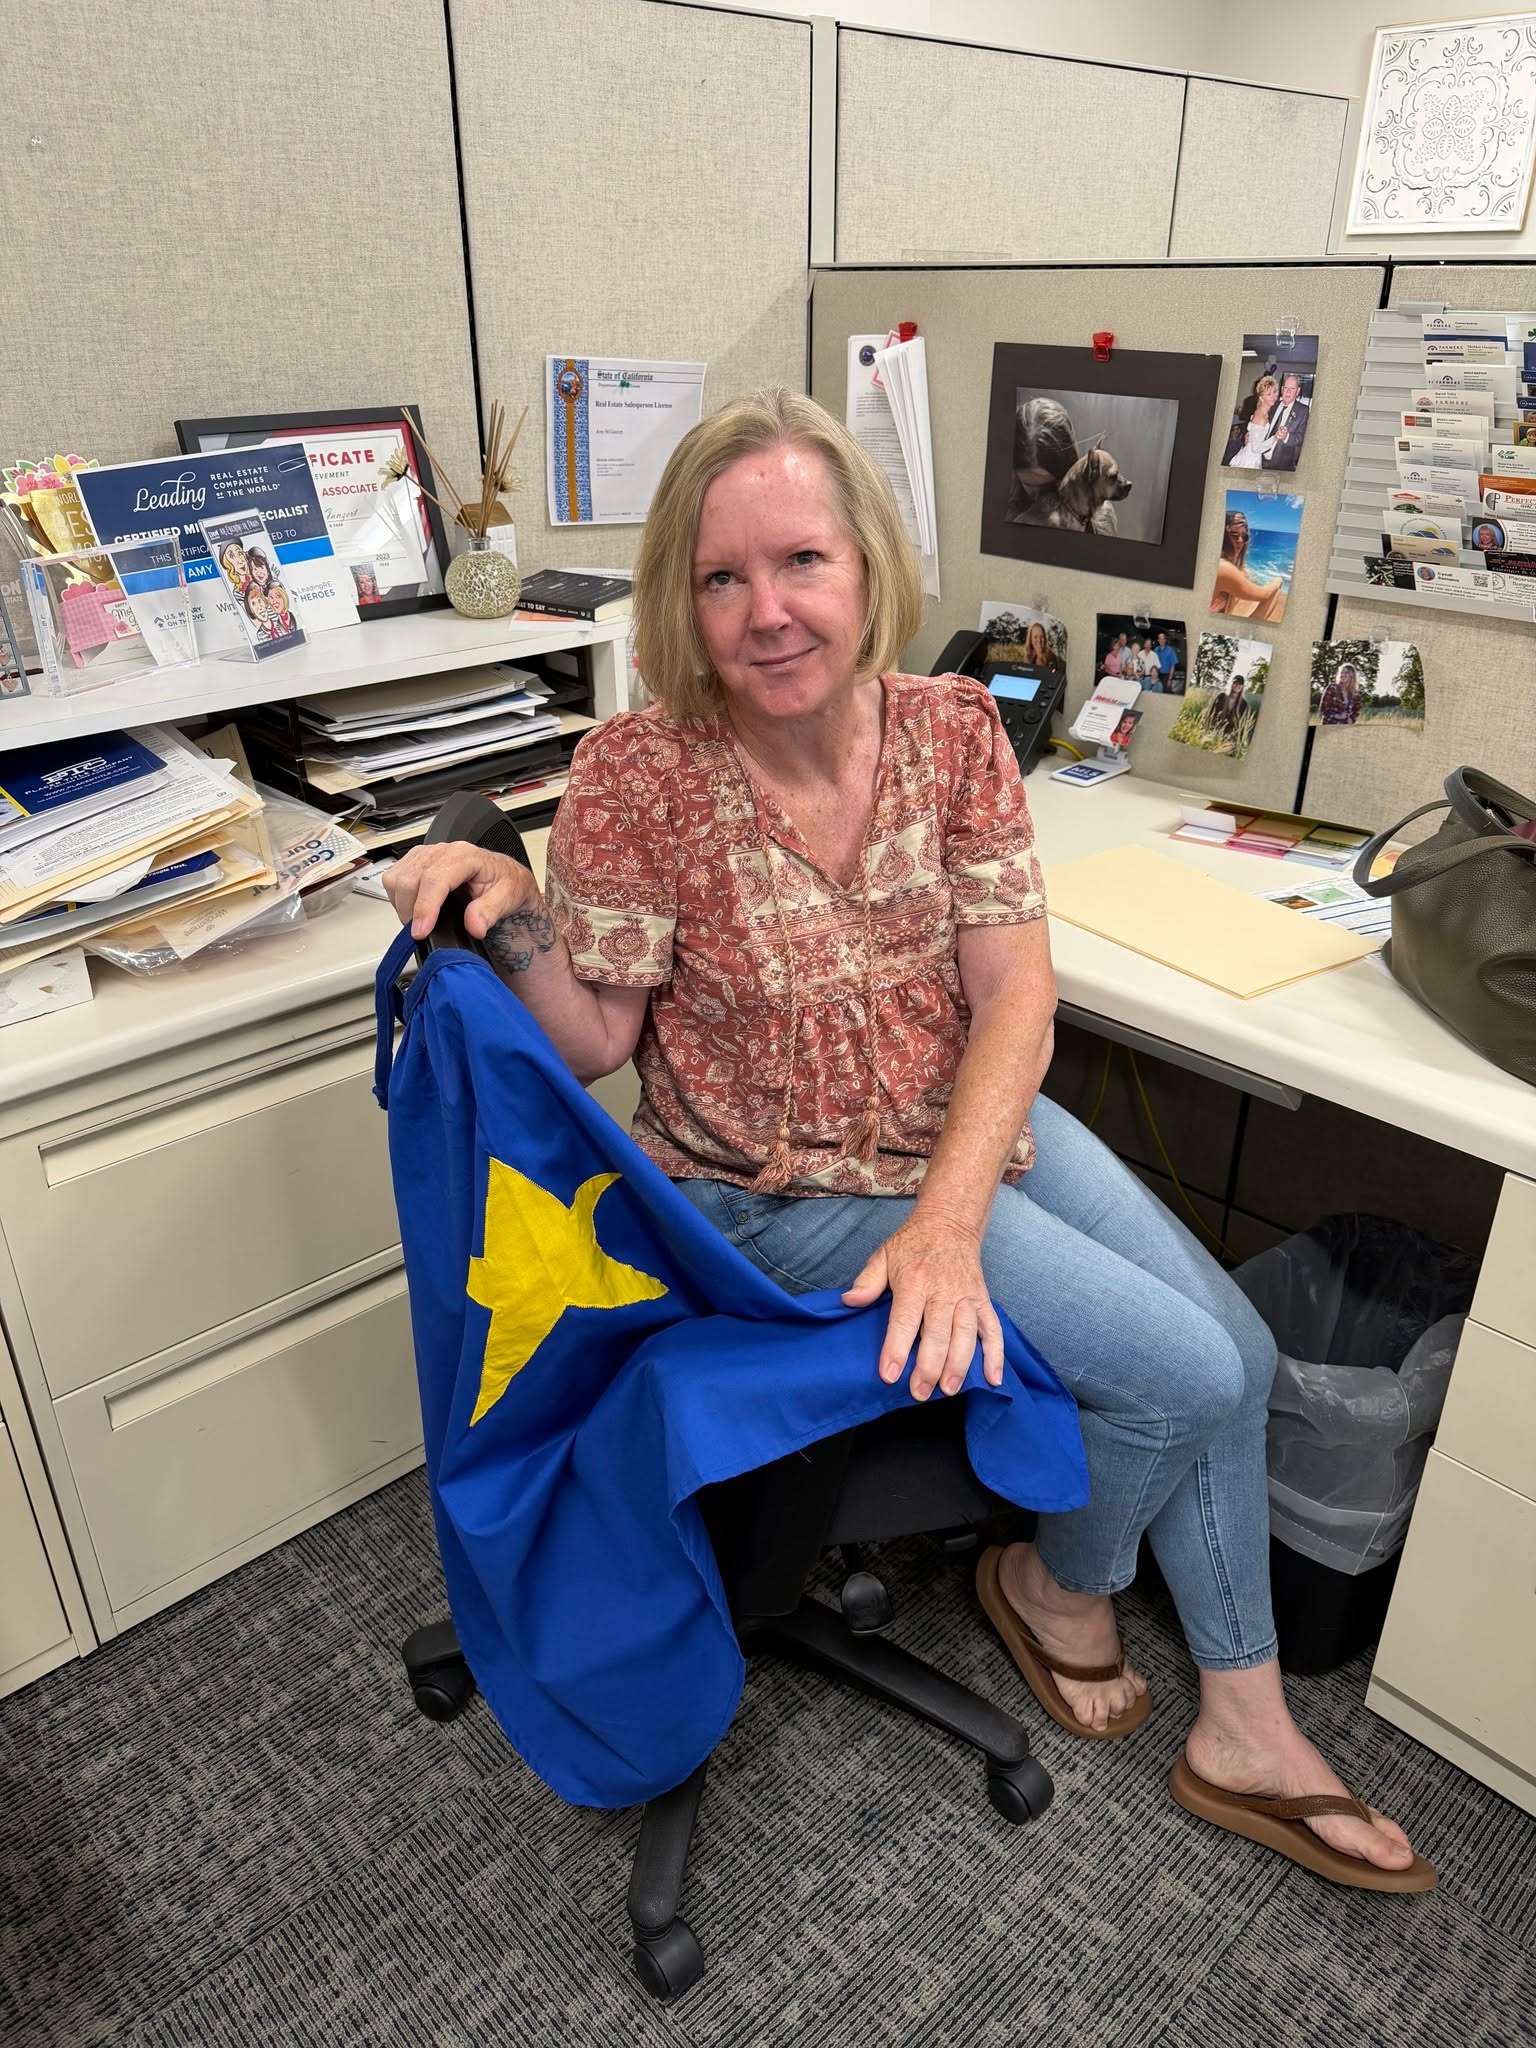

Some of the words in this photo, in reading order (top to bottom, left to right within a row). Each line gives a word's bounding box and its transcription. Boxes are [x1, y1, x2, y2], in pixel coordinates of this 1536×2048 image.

[596, 370, 613, 380] State
[622, 372, 654, 381] California
[595, 400, 607, 408] Real
[624, 401, 654, 409] Salesperson
[308, 449, 376, 467] FICATE
[210, 471, 234, 481] REAL
[236, 466, 269, 477] ESTATE
[314, 471, 350, 480] EVEMENT
[213, 476, 265, 490] COMPANIES
[322, 483, 379, 497] ASSOCIATE
[133, 471, 206, 512] Leading
[226, 488, 244, 497] THE
[56, 492, 81, 506] WORL
[260, 504, 309, 522] ECIALIST
[51, 511, 94, 539] BES
[149, 553, 172, 565] THIS
[180, 544, 210, 557] RTIFICA
[285, 529, 297, 538] TO
[375, 552, 391, 561] 2023
[187, 564, 213, 579] AMY
[297, 581, 333, 594] LeadingRE
[300, 589, 336, 603] HEROES
[527, 602, 535, 610] TO
[535, 603, 546, 611] SAY
[163, 612, 178, 621] U.S.
[24, 780, 62, 796] PLACER
[64, 771, 89, 782] TITLE
[92, 755, 133, 773] COMPANY
[1071, 766, 1098, 777] MLS
[287, 839, 322, 858] Our
[280, 849, 335, 879] Cards
[183, 908, 229, 937] Windermere
